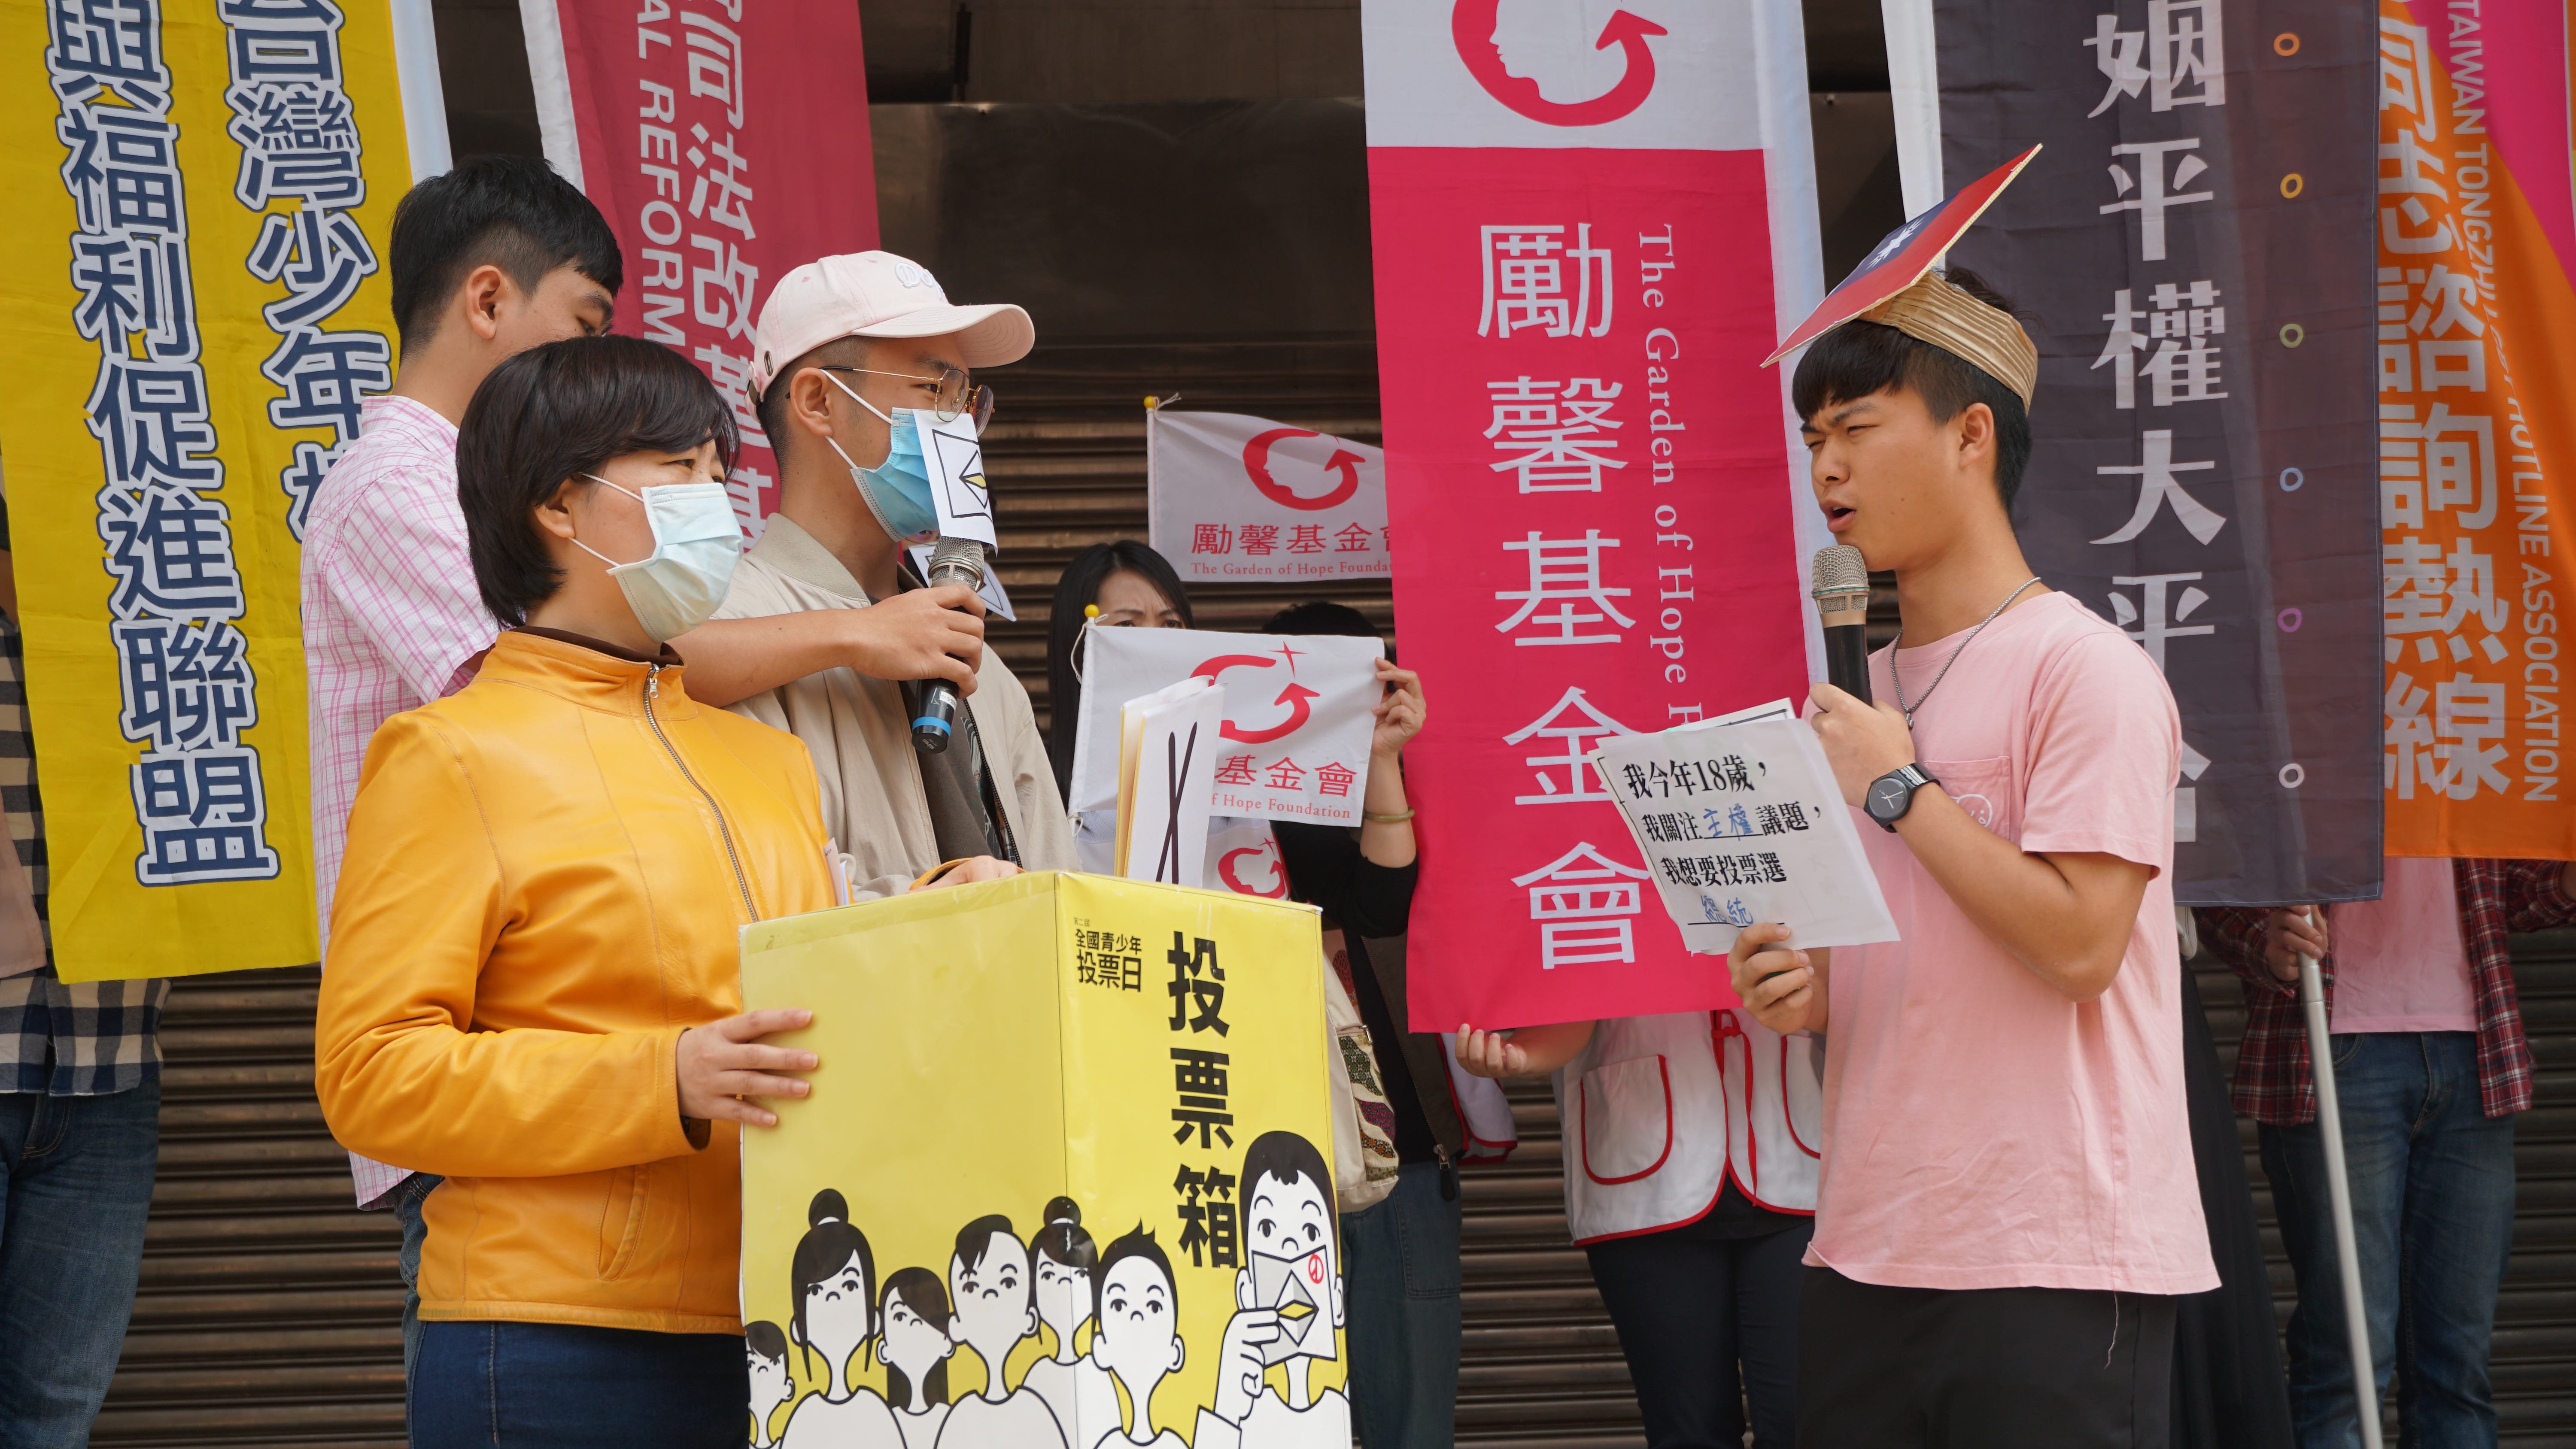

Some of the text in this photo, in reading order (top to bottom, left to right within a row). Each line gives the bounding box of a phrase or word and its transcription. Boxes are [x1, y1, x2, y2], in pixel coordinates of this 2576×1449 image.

[2447, 0, 2486, 135] TAIWAN
[639, 79, 686, 347] REFORM
[1638, 223, 1676, 309] The
[2454, 143, 2495, 301] TONGZHI
[680, 0, 773, 555] 司法改革
[45, 0, 279, 886] 與福利促進聯盟
[1644, 327, 1686, 486] Garden
[2082, 0, 2228, 842] 姻平權大平
[1191, 562, 1217, 574] The
[1223, 563, 1272, 575] Garden
[1278, 563, 1291, 575] of
[1297, 563, 1333, 577] Hope
[1654, 504, 1694, 551] of
[1477, 222, 1652, 970] 勵馨基金會
[1649, 564, 1694, 683] Hope
[2521, 562, 2559, 802] ASSOCIATION
[1211, 793, 1351, 819] f Hope Foundation
[1214, 754, 1358, 797] 基金會
[1660, 852, 1787, 887] 我想要投票選
[1700, 894, 1754, 925] 總統
[1075, 928, 1142, 955] 全國青少年
[1076, 949, 1142, 993] 投票日
[1166, 930, 1239, 1270] 投票箱
